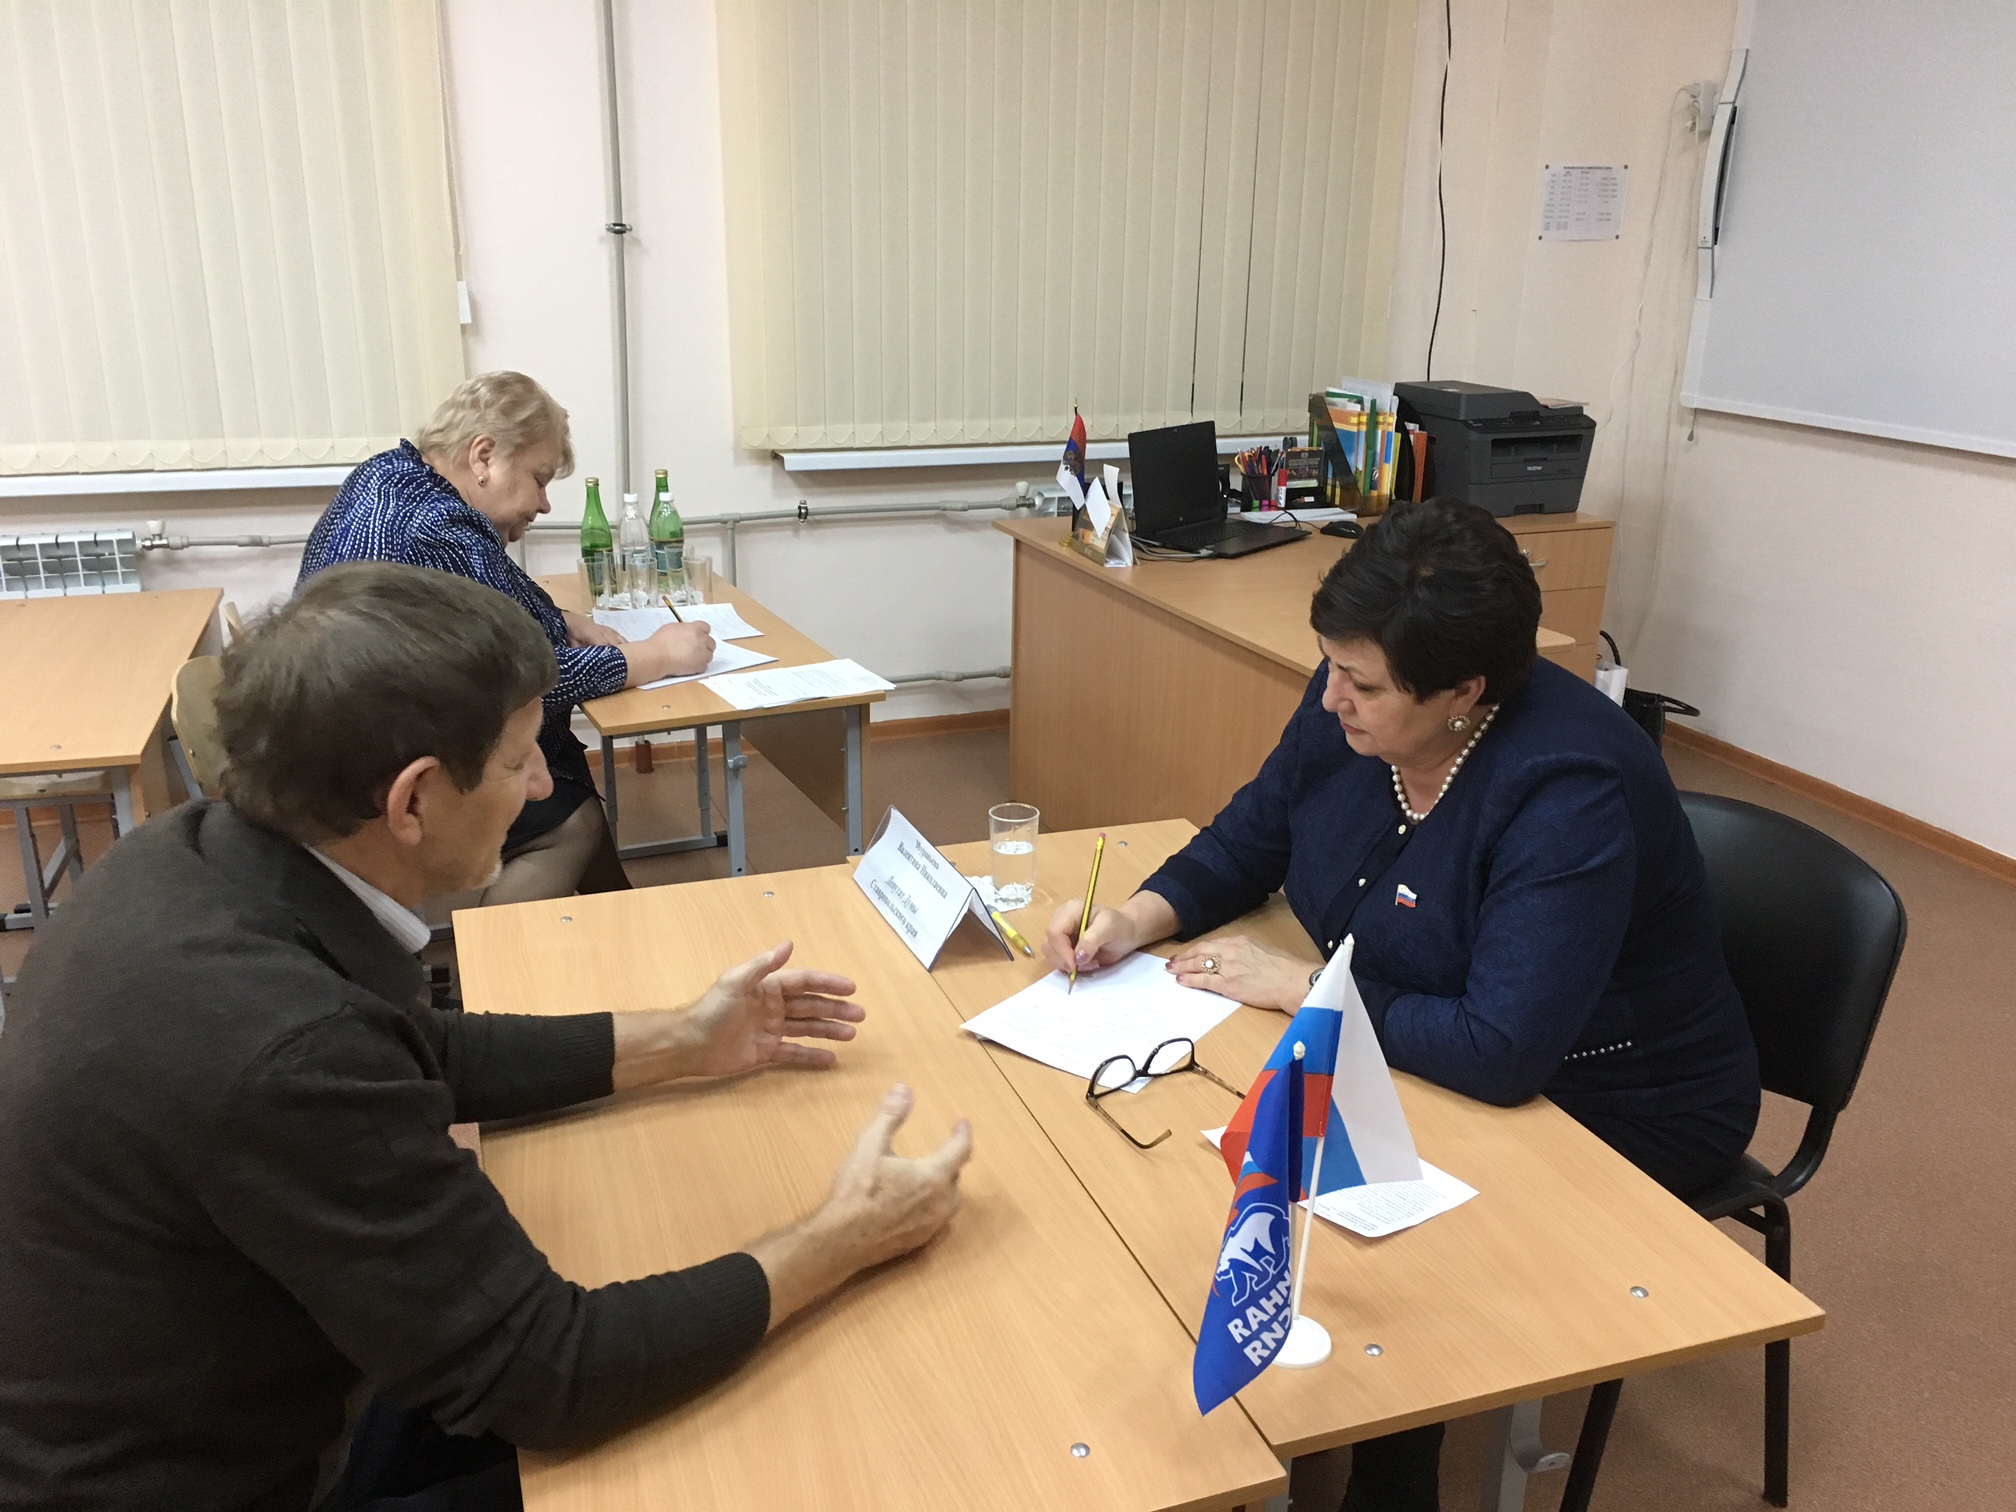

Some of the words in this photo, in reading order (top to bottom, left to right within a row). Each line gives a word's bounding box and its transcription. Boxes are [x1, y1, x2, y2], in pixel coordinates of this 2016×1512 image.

[884, 875, 905, 899] Депутат
[902, 894, 919, 914] Думы
[897, 841, 921, 871] Валентина
[919, 864, 948, 899] Николаевна
[870, 879, 907, 925] Ставропольского
[904, 921, 919, 938] края
